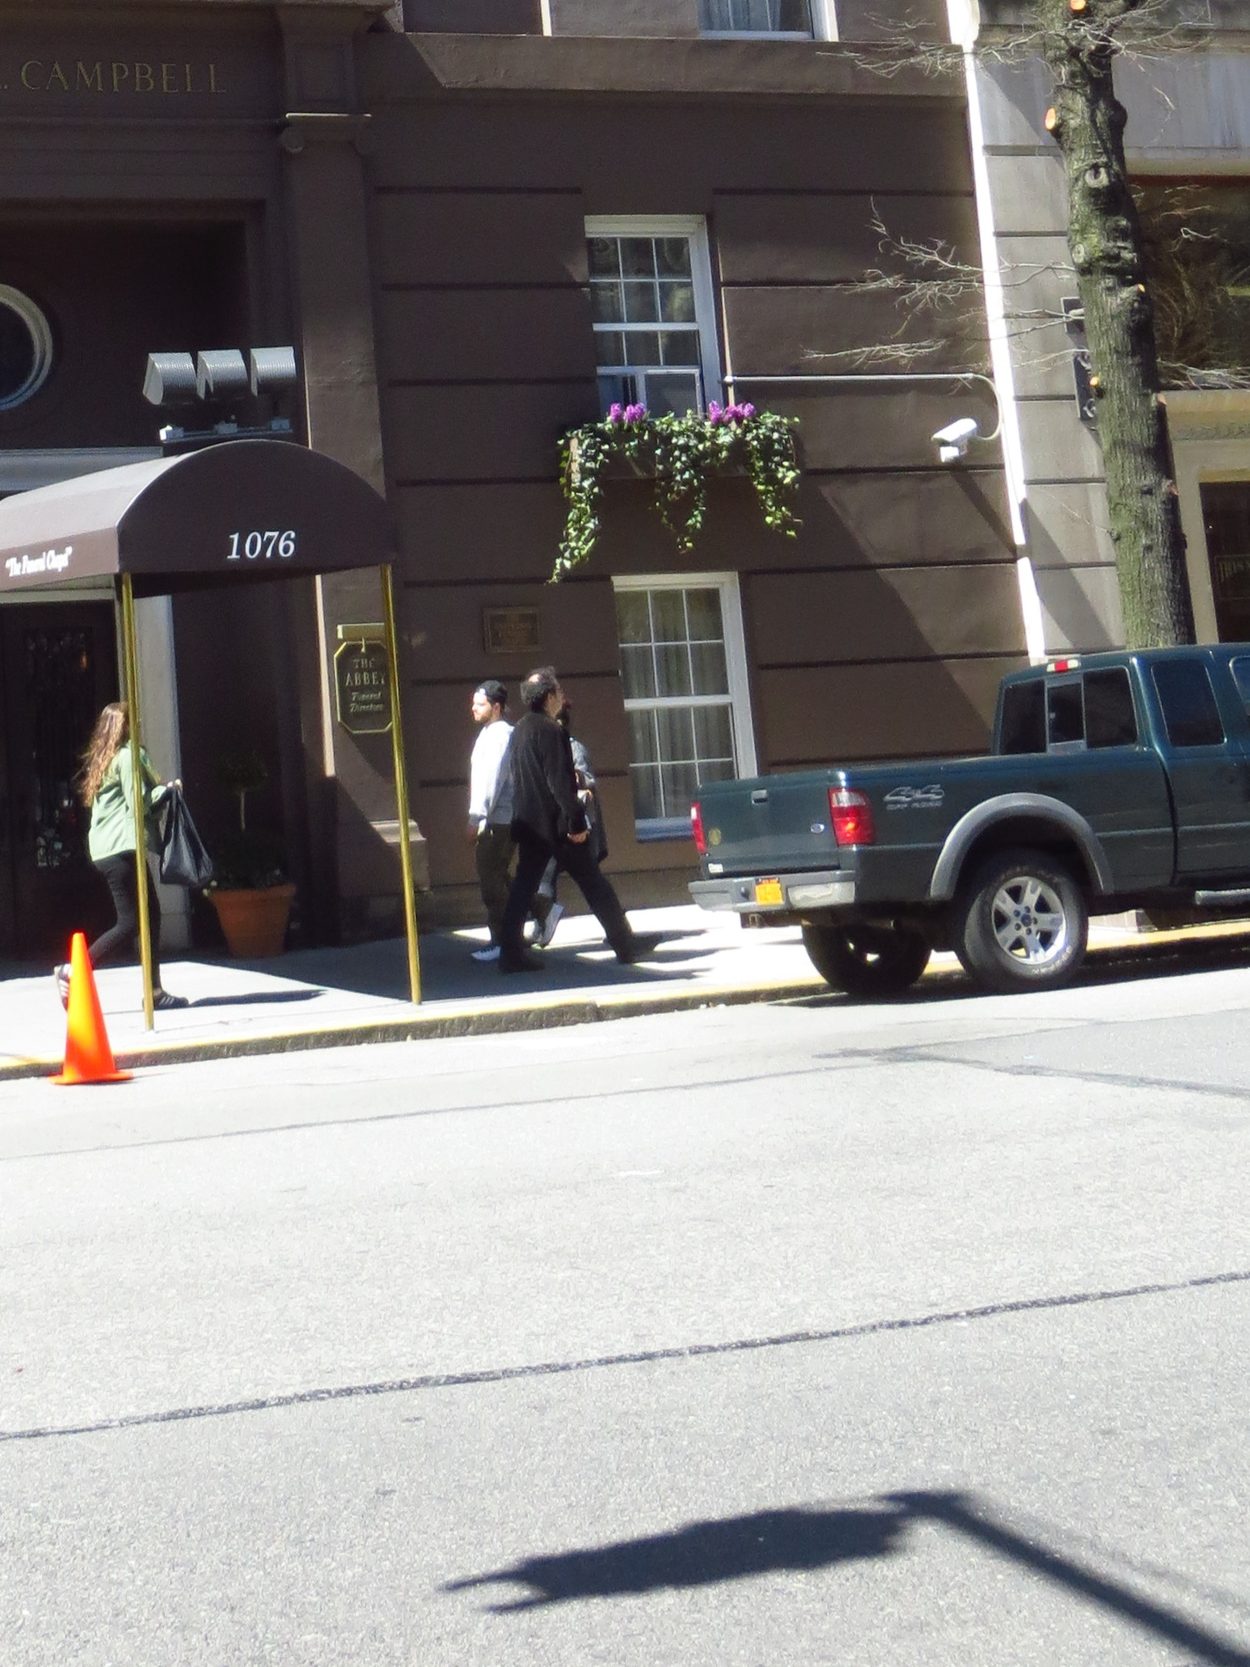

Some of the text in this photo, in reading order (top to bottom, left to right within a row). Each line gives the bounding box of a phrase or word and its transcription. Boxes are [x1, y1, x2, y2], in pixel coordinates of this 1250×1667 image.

[21, 60, 227, 94] CAMPBELL
[226, 530, 296, 560] 1076
[345, 671, 386, 686] ABBEY
